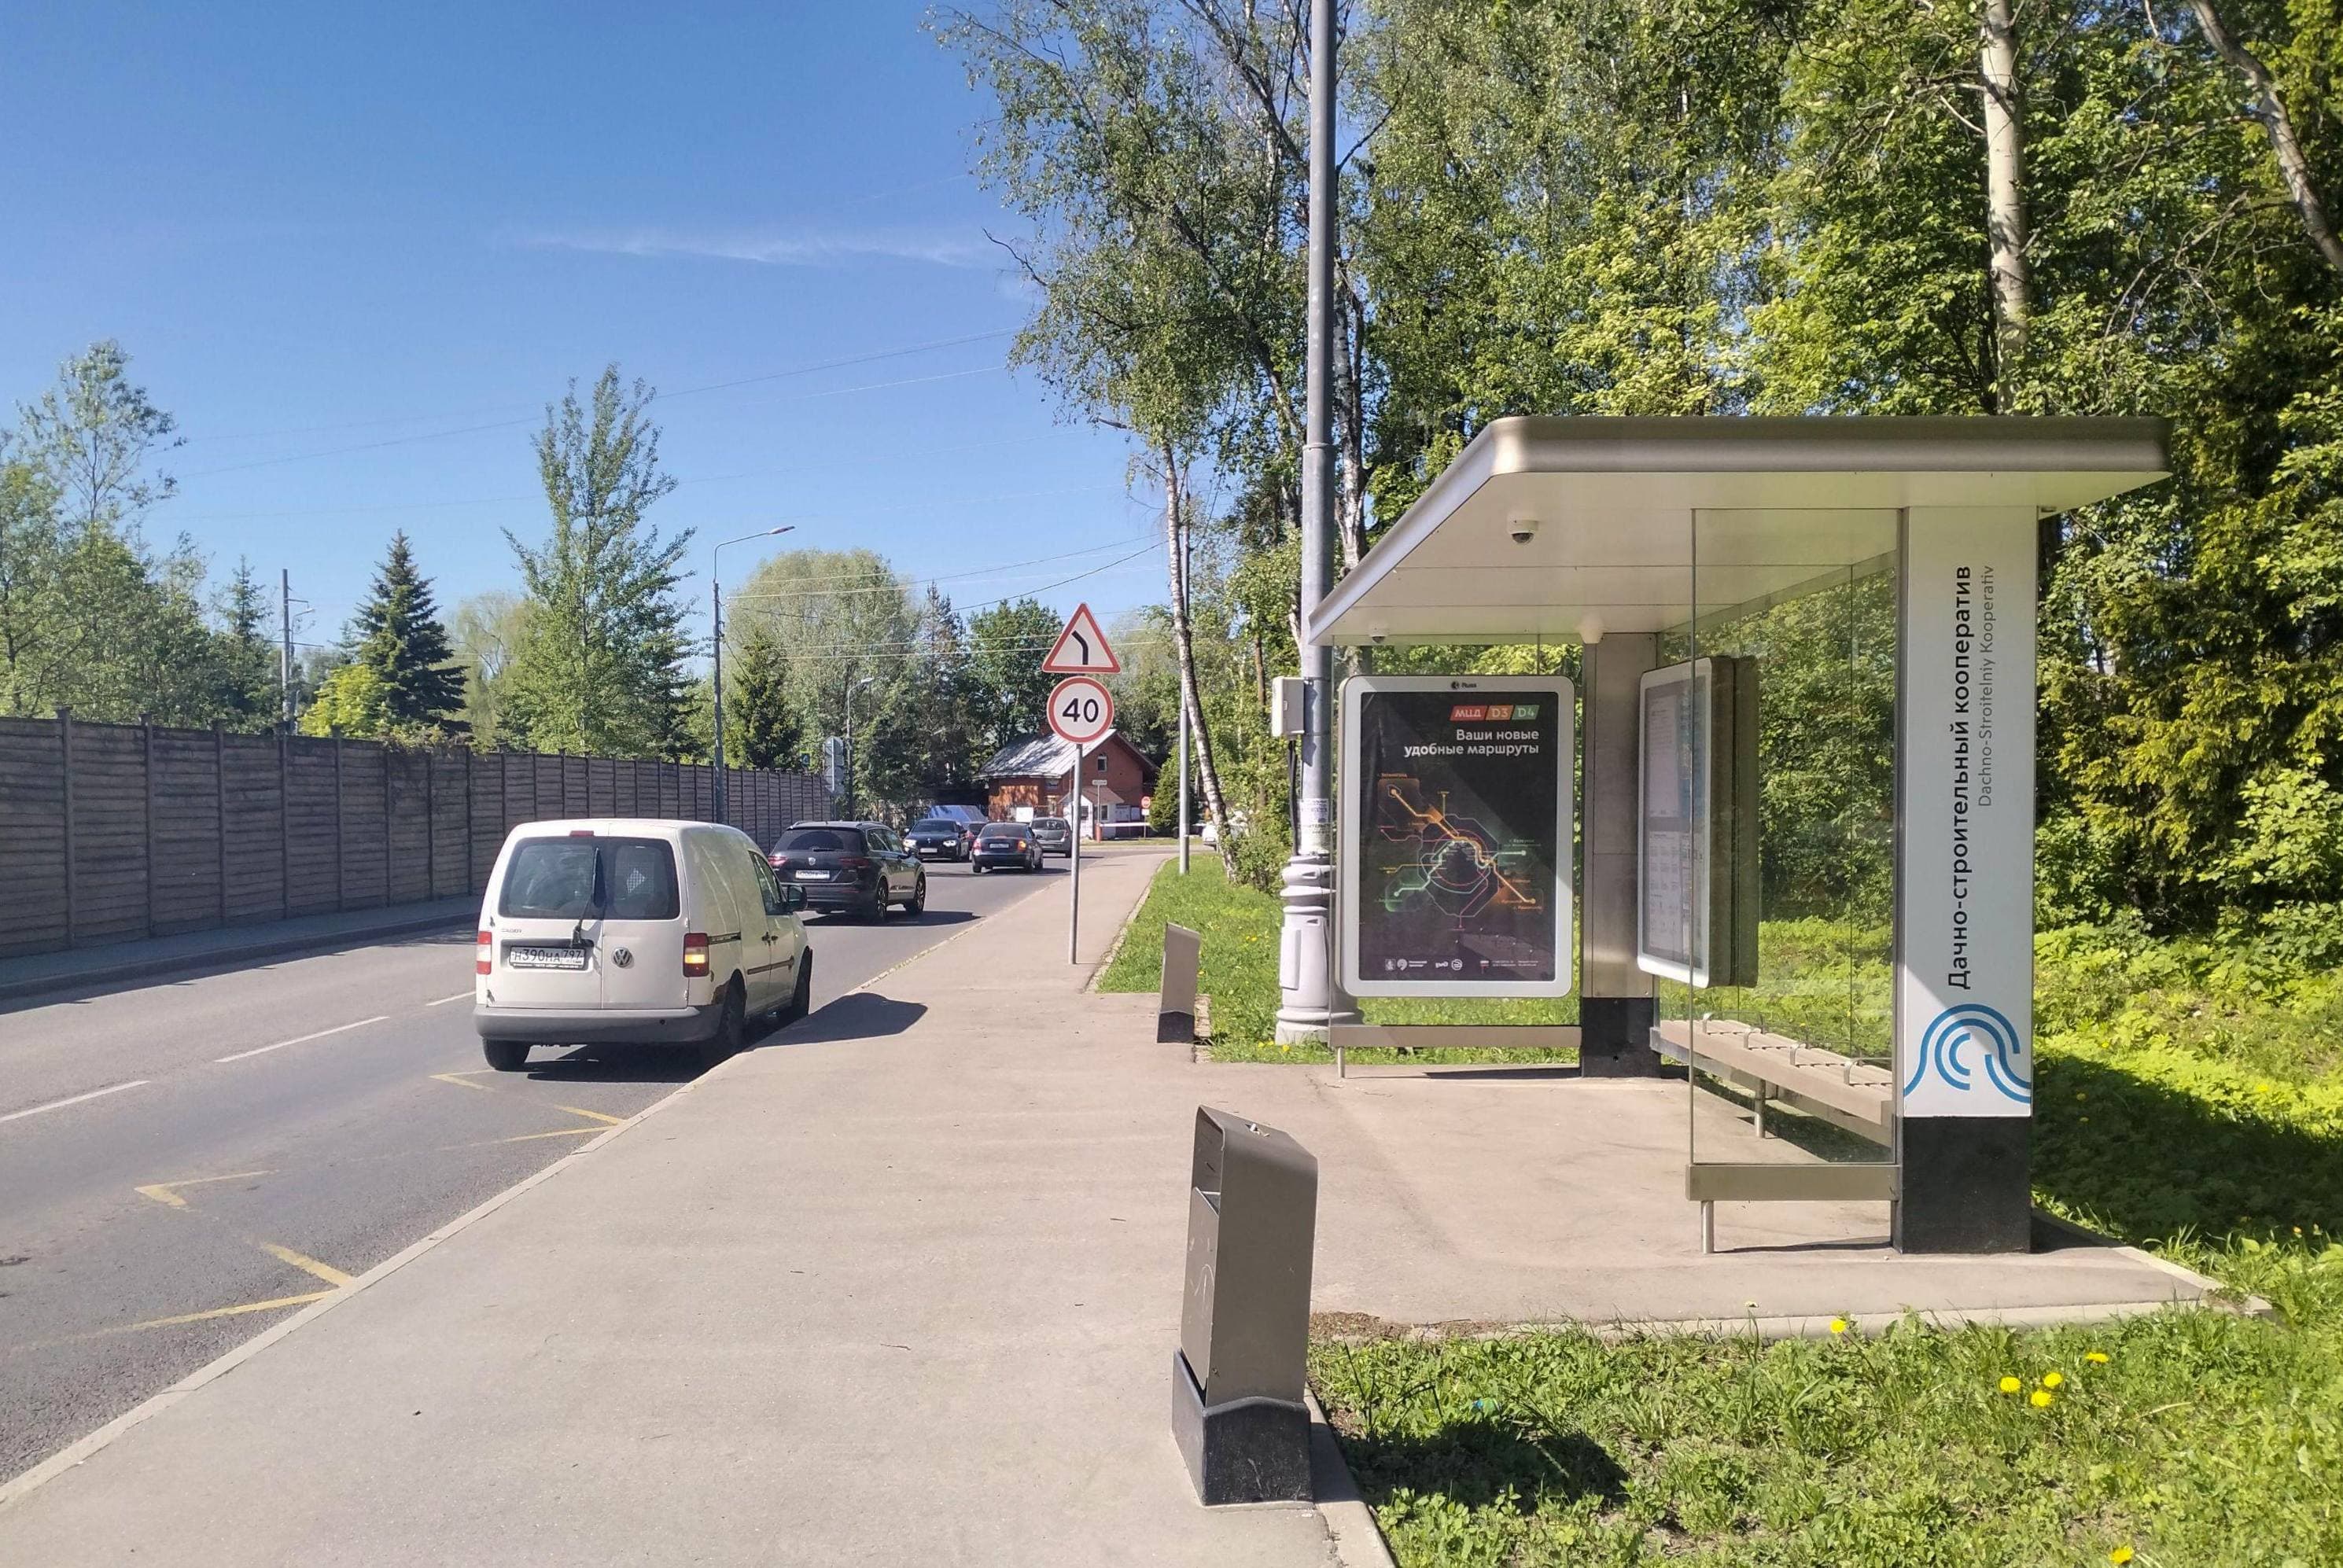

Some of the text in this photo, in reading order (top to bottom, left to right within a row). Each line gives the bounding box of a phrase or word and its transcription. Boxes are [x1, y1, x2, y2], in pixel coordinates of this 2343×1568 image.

[1977, 565, 1996, 807] Dachno-Stroitelniy Kooperativ
[1062, 698, 1099, 723] 40
[1491, 709, 1509, 718] D3
[1517, 709, 1534, 717] D4
[1456, 728, 1539, 741] Ваши новые
[1404, 742, 1539, 757] удобные маршруты
[1947, 565, 1975, 990] Дачно-строительный кооператив
